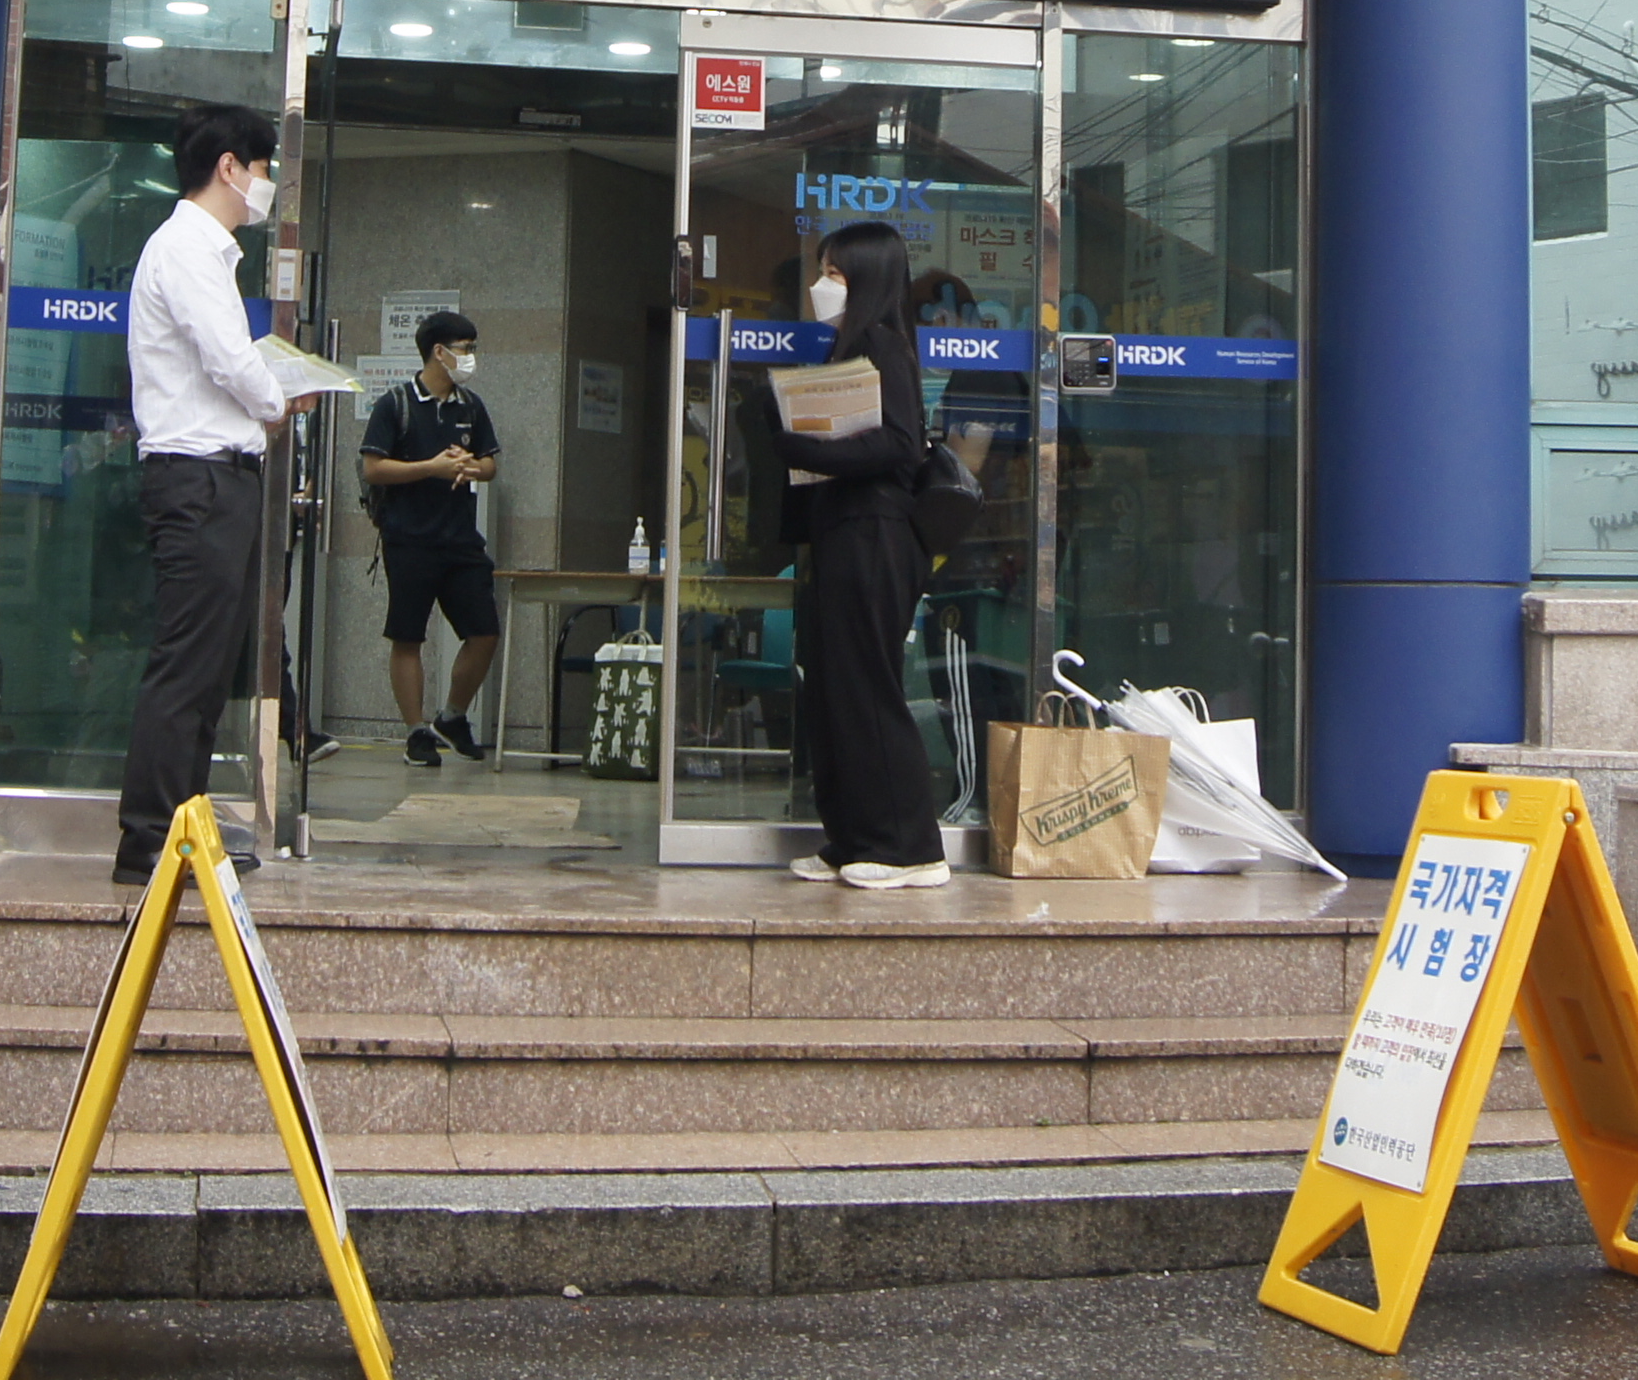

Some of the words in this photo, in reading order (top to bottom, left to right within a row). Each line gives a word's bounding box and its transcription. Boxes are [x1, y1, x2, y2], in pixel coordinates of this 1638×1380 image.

[705, 73, 751, 93] 에스원
[695, 113, 732, 124] SECOM
[960, 226, 1015, 246] 마스크
[389, 314, 411, 328] 체온
[1409, 860, 1512, 919] 국가자격
